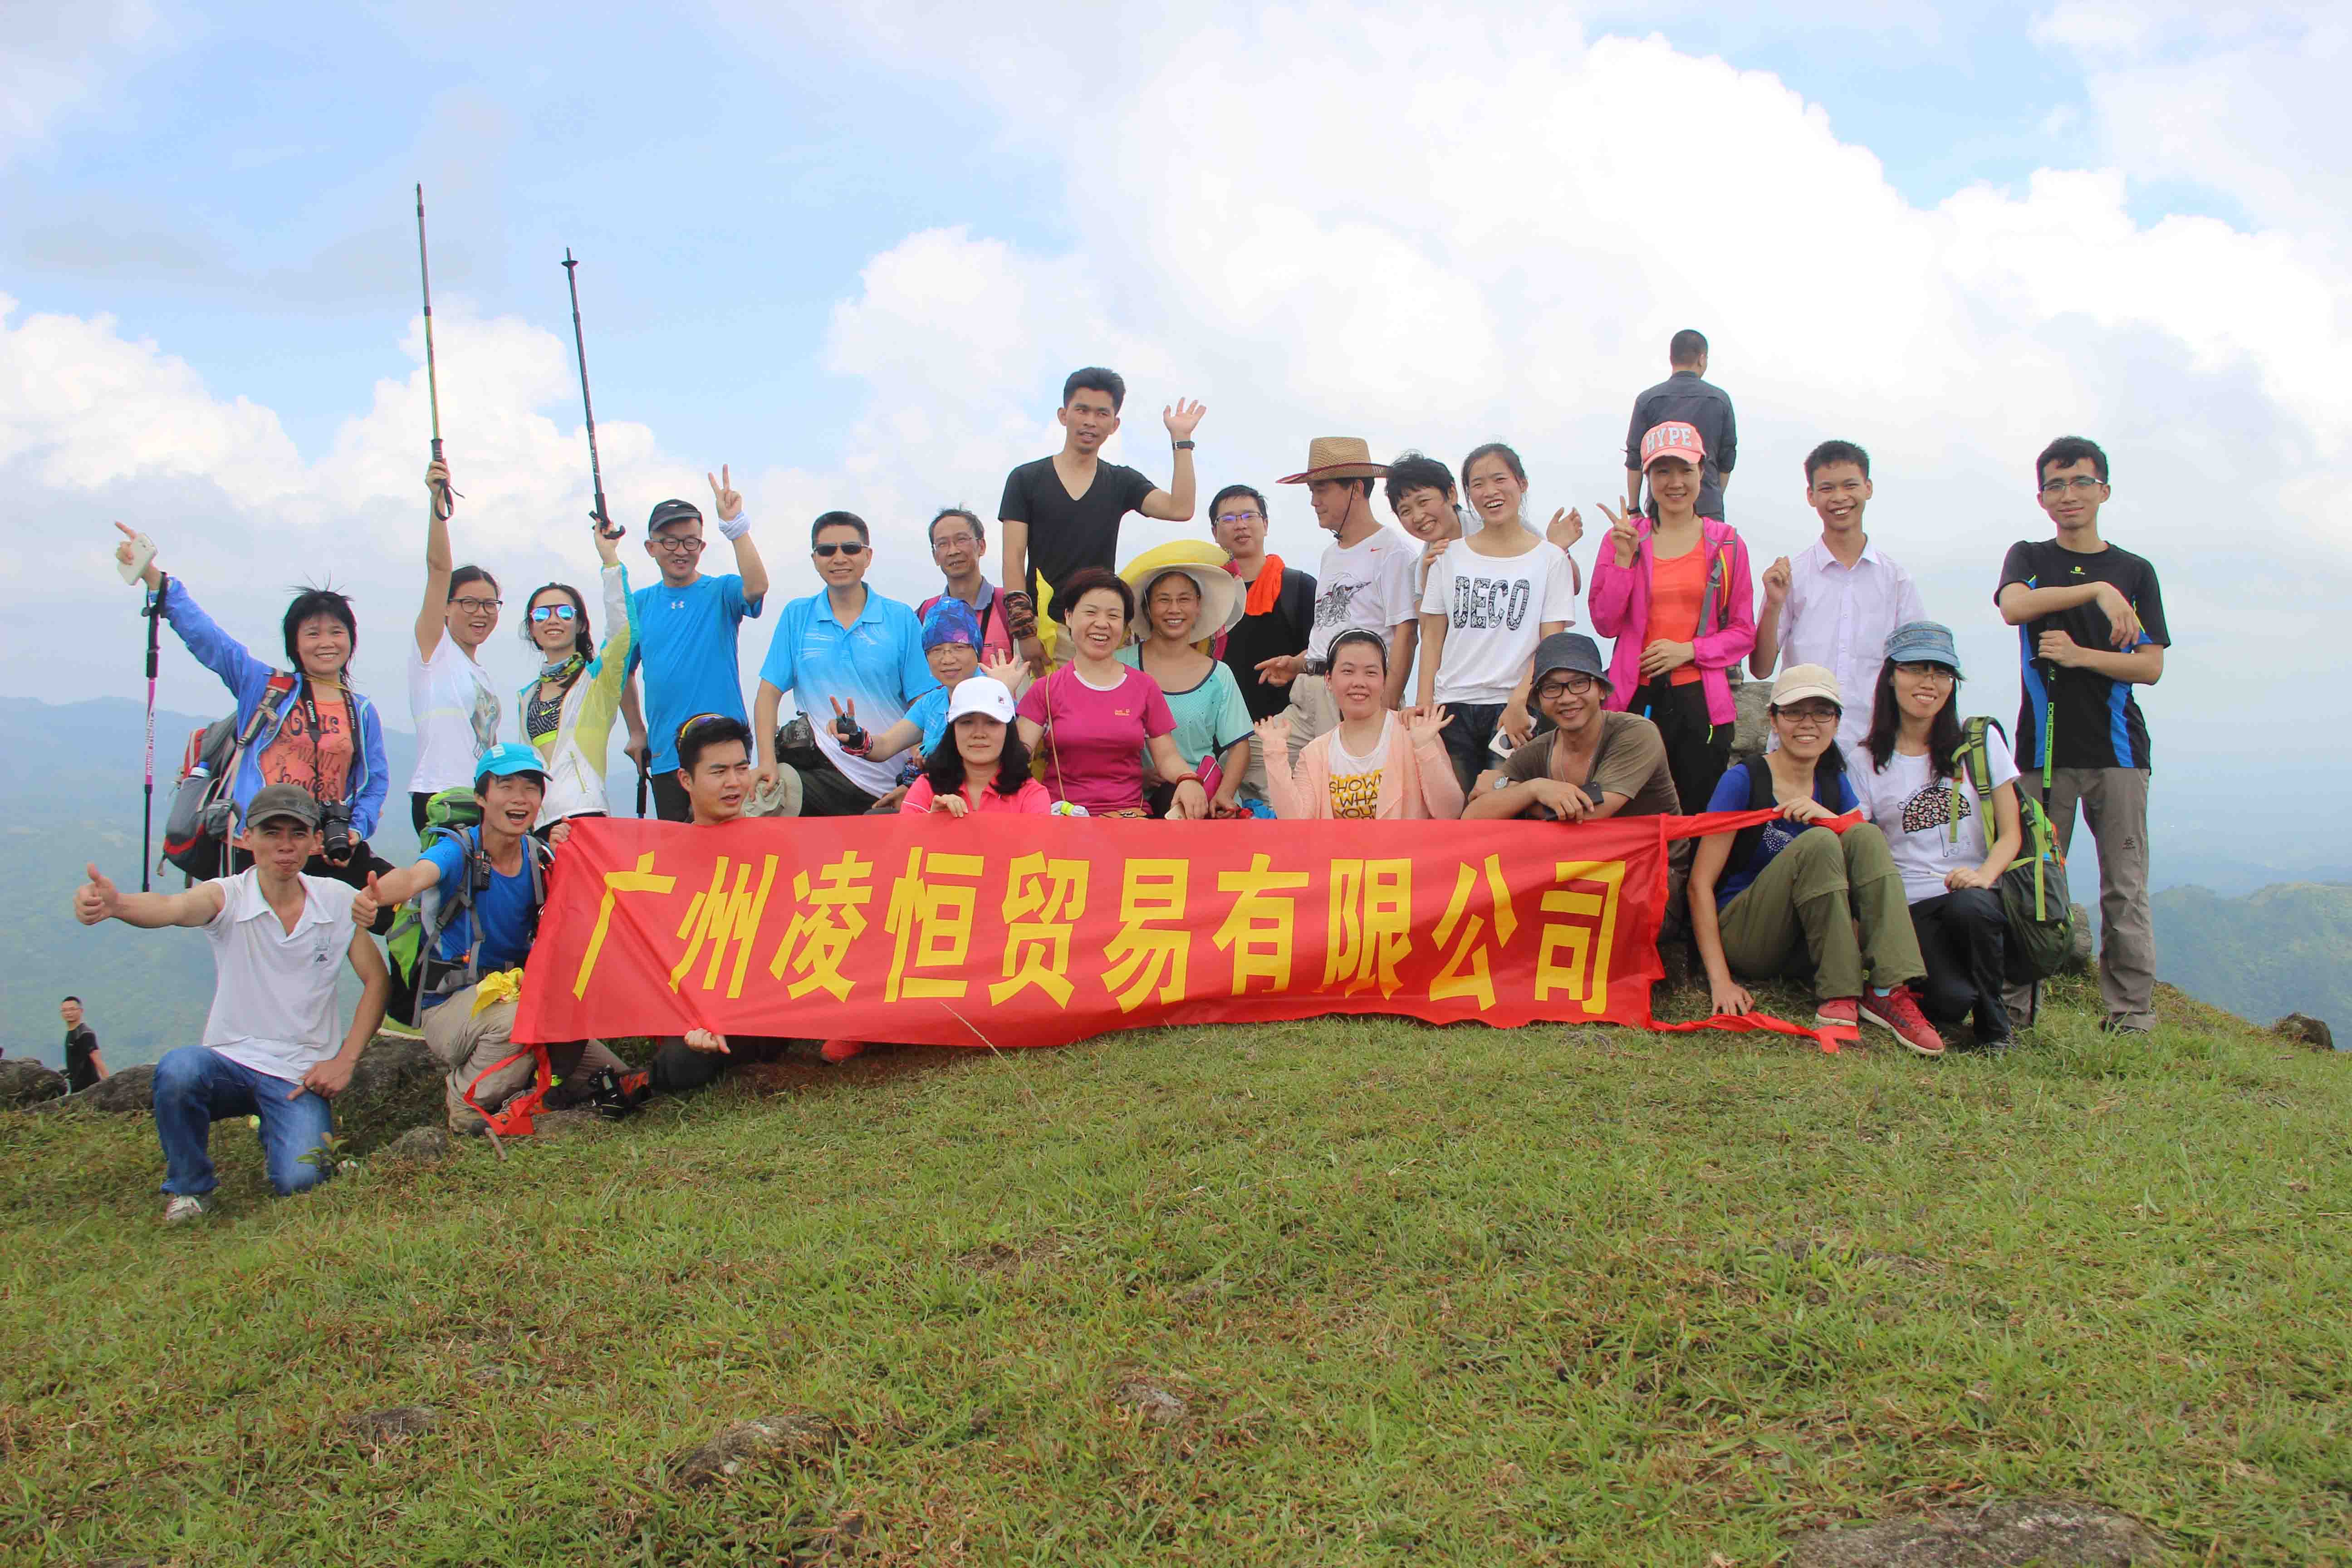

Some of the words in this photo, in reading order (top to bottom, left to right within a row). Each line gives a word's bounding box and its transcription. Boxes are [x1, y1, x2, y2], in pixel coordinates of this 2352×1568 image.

[1646, 428, 1692, 454] HYPE
[1453, 576, 1530, 631] DECO
[1340, 790, 1378, 807] WHA
[573, 847, 1627, 1014] 广州凌恒贸易有限公司
